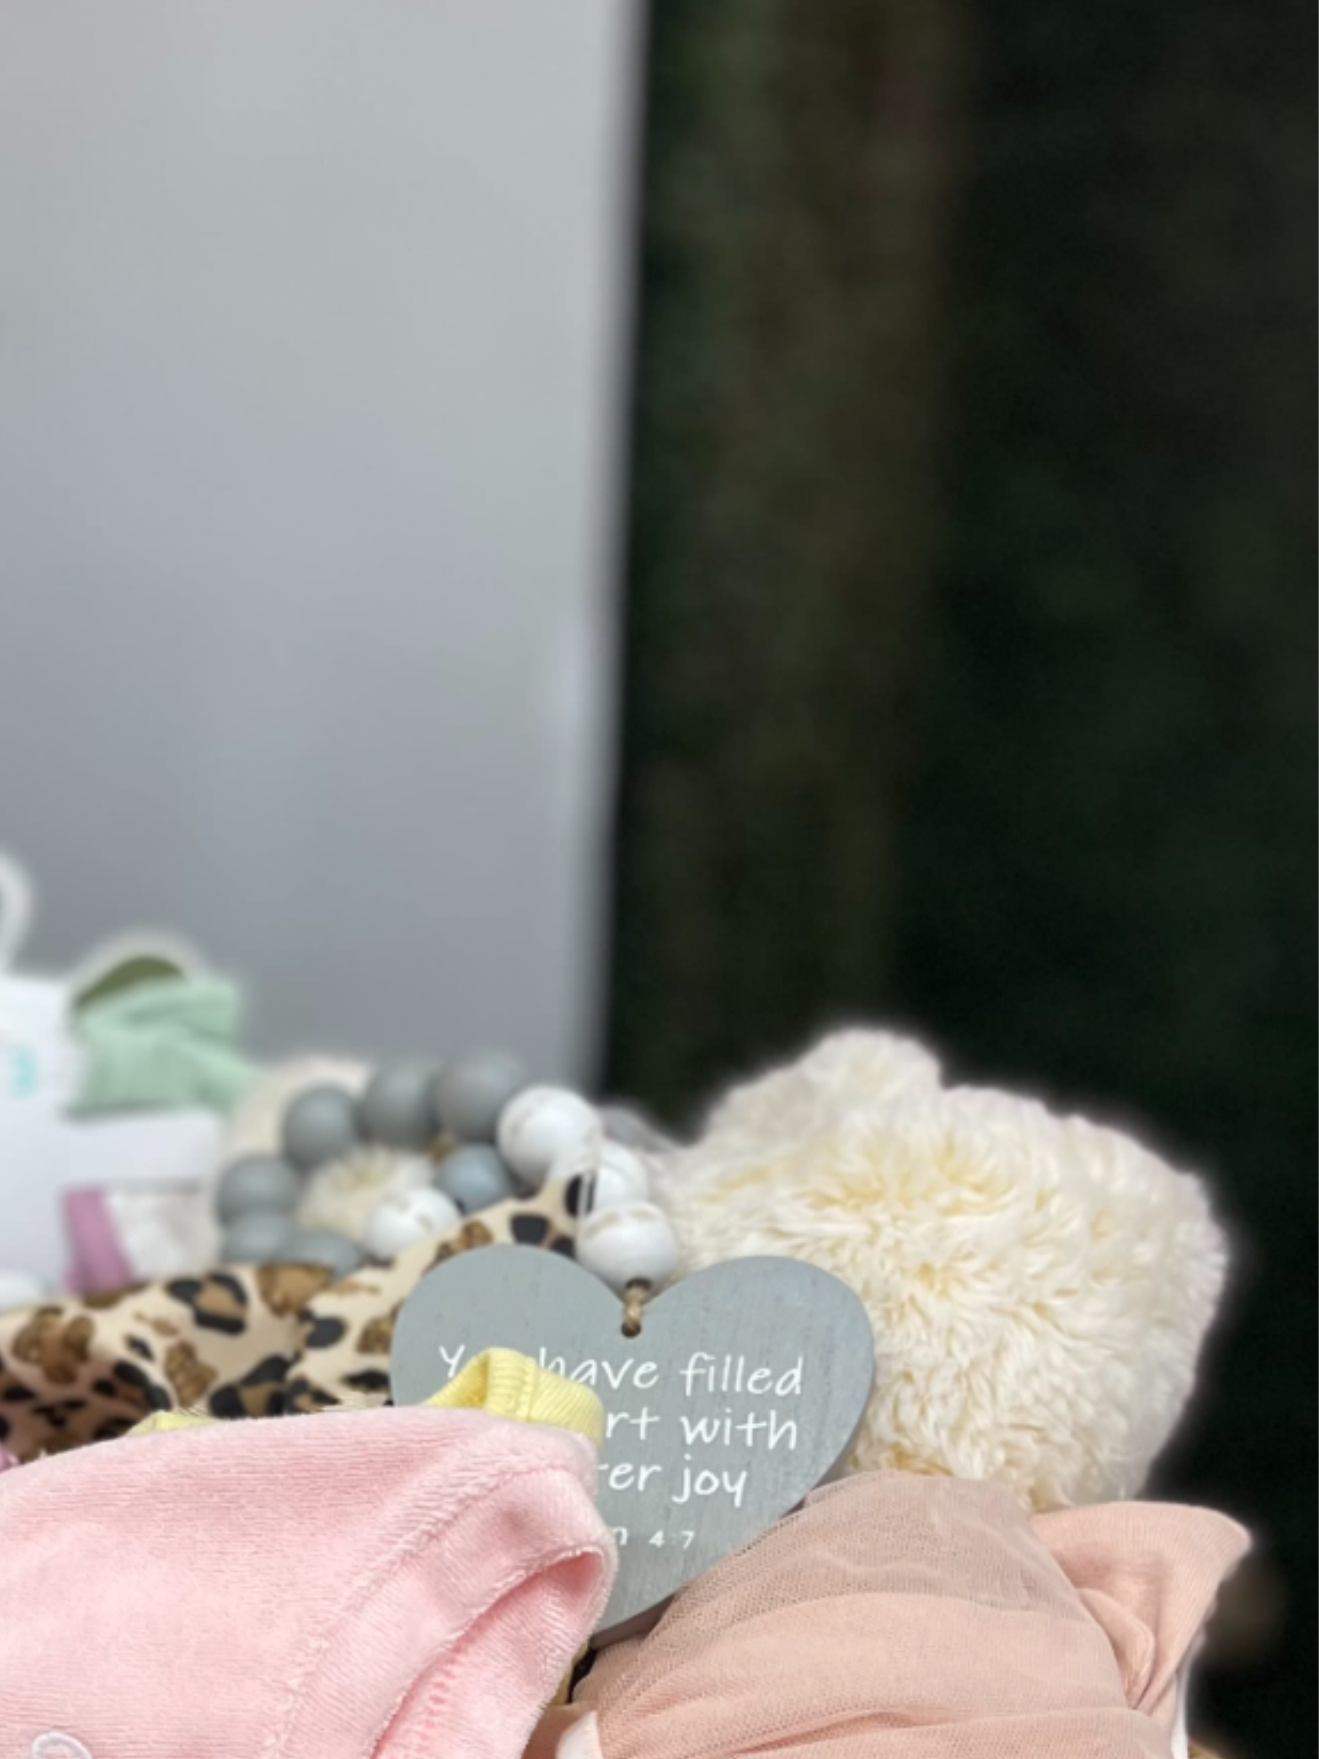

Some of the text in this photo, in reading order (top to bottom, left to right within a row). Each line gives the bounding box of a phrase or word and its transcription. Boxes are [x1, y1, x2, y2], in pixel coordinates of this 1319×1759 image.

[680, 1352, 803, 1396] filled
[679, 1407, 797, 1450] with
[672, 1453, 748, 1508] joy
[648, 1529, 695, 1550] 4:7
